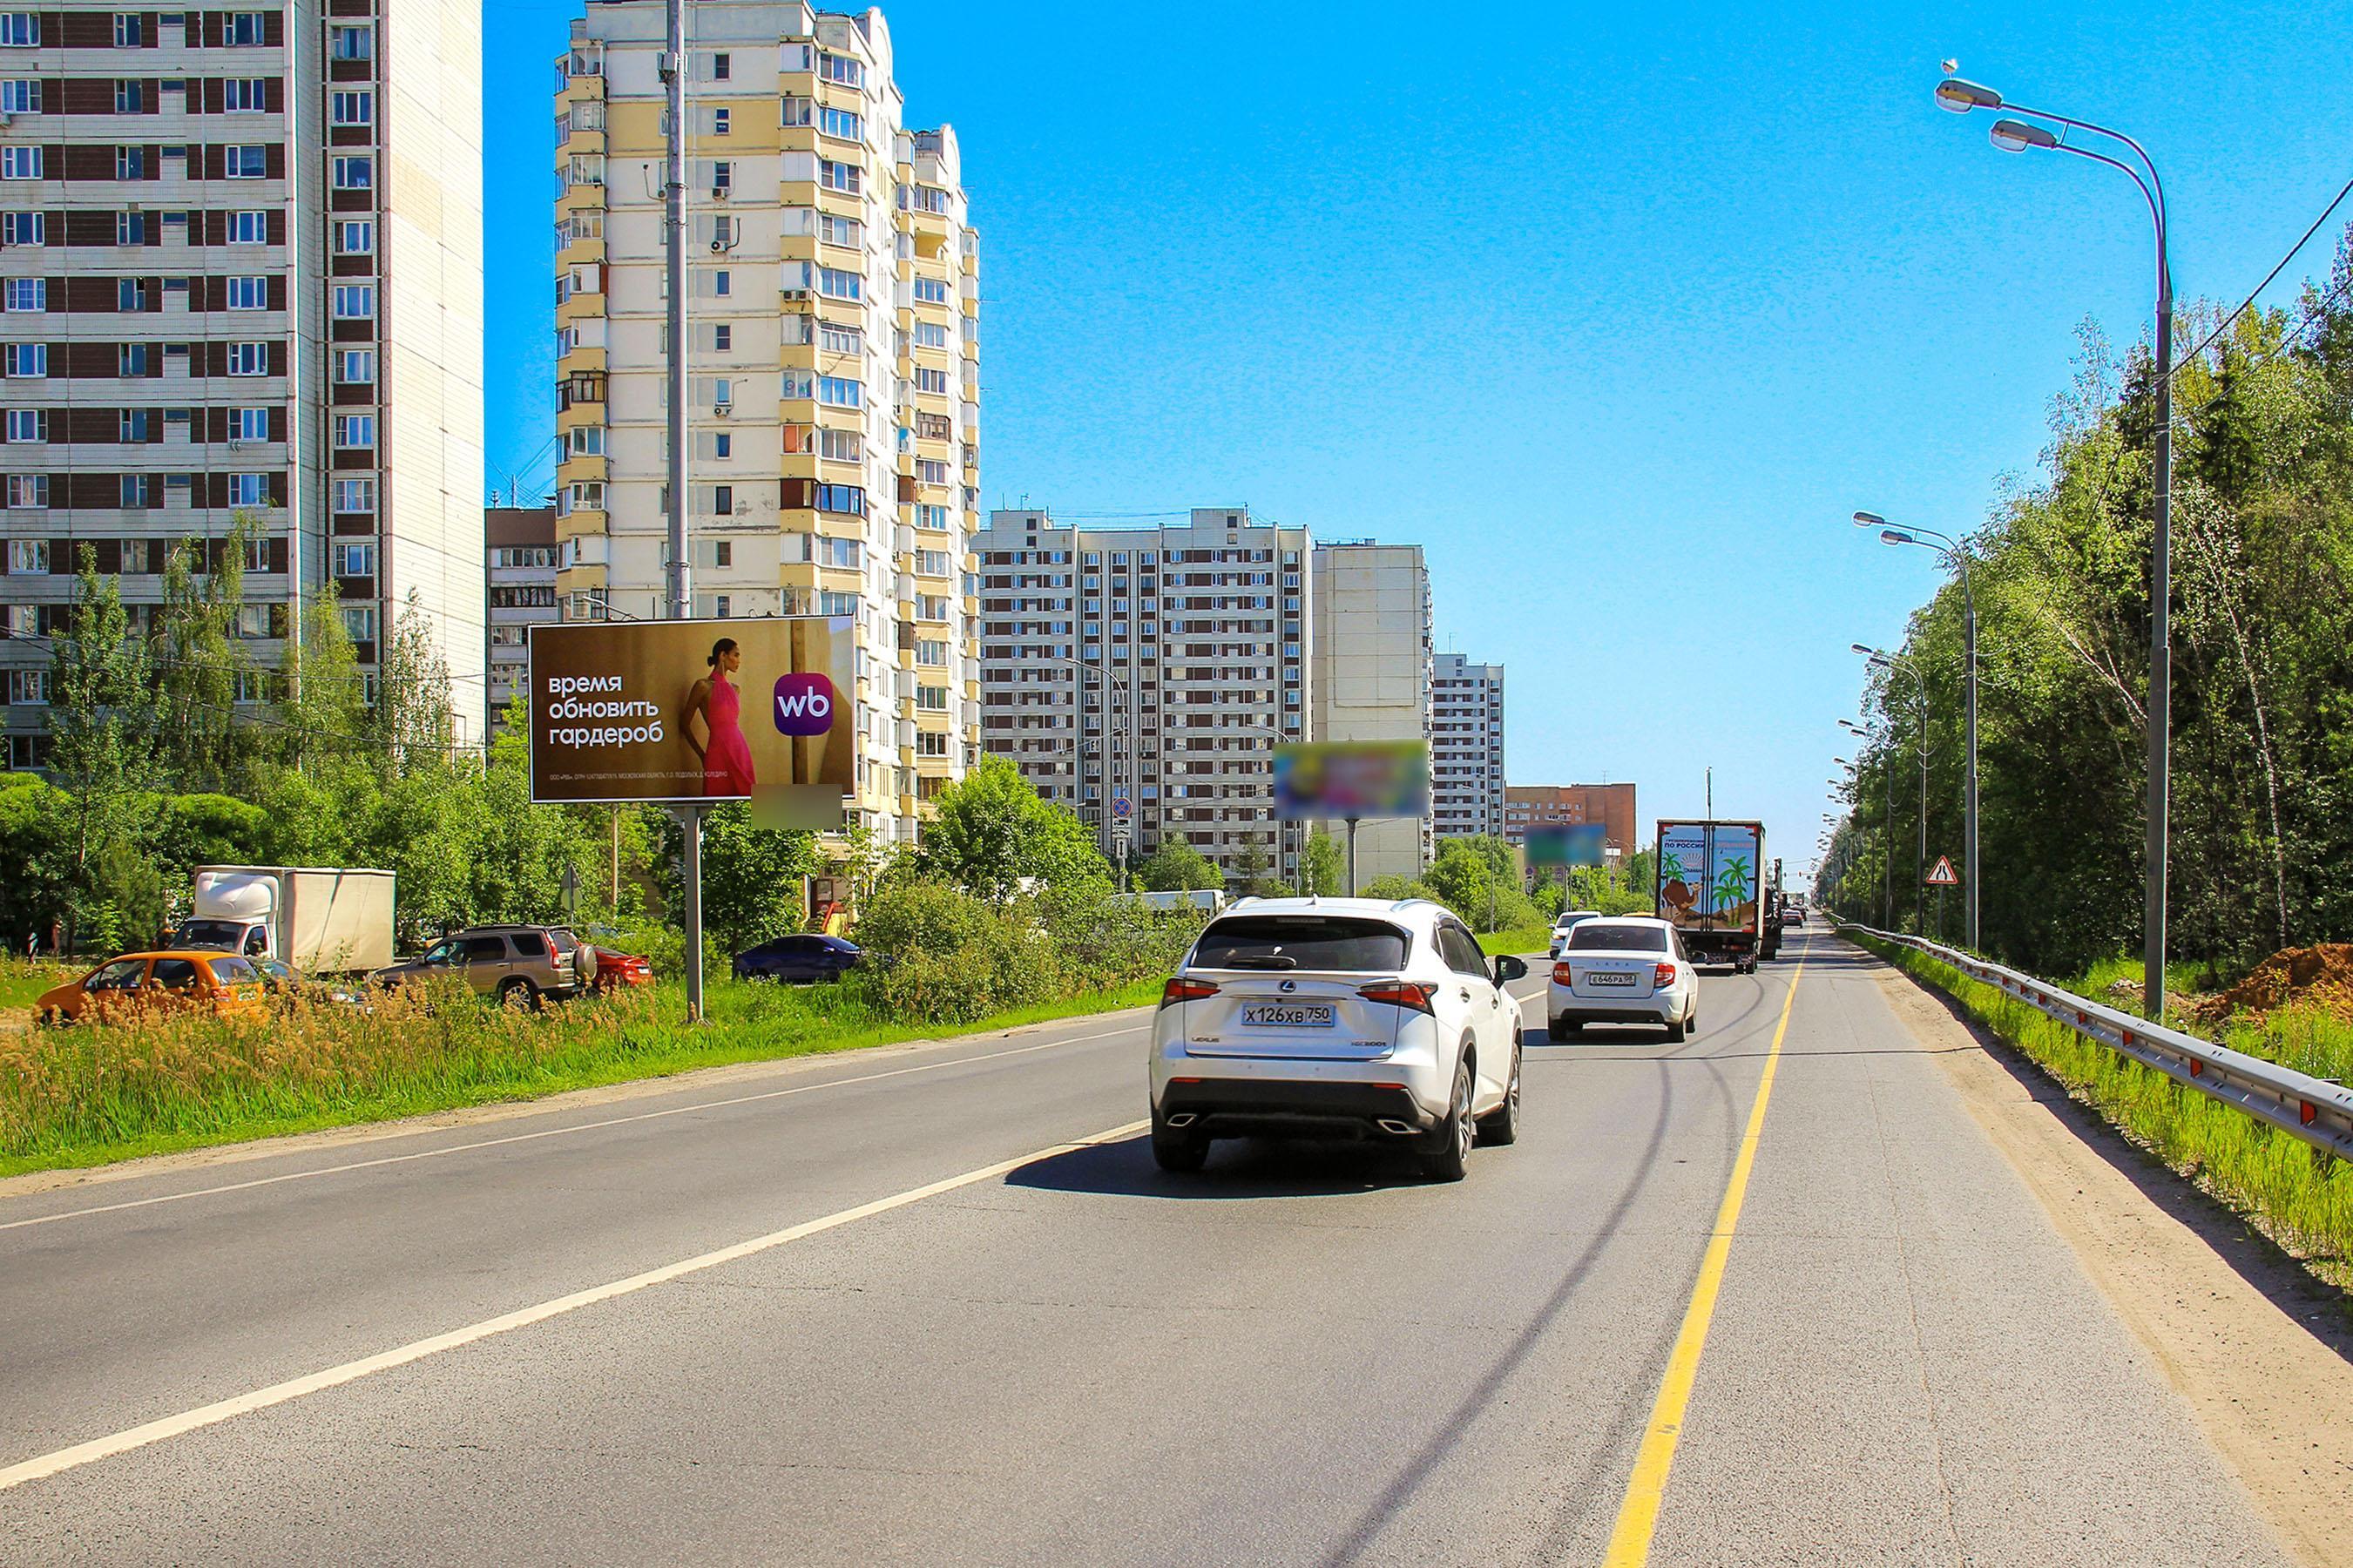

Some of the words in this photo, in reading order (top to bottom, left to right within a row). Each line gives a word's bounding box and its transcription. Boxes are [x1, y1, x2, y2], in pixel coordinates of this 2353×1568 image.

[549, 676, 622, 698] время
[549, 696, 659, 720] обновить
[777, 686, 829, 717] wb
[549, 720, 664, 749] гардероб
[1307, 1007, 1329, 1019] 750
